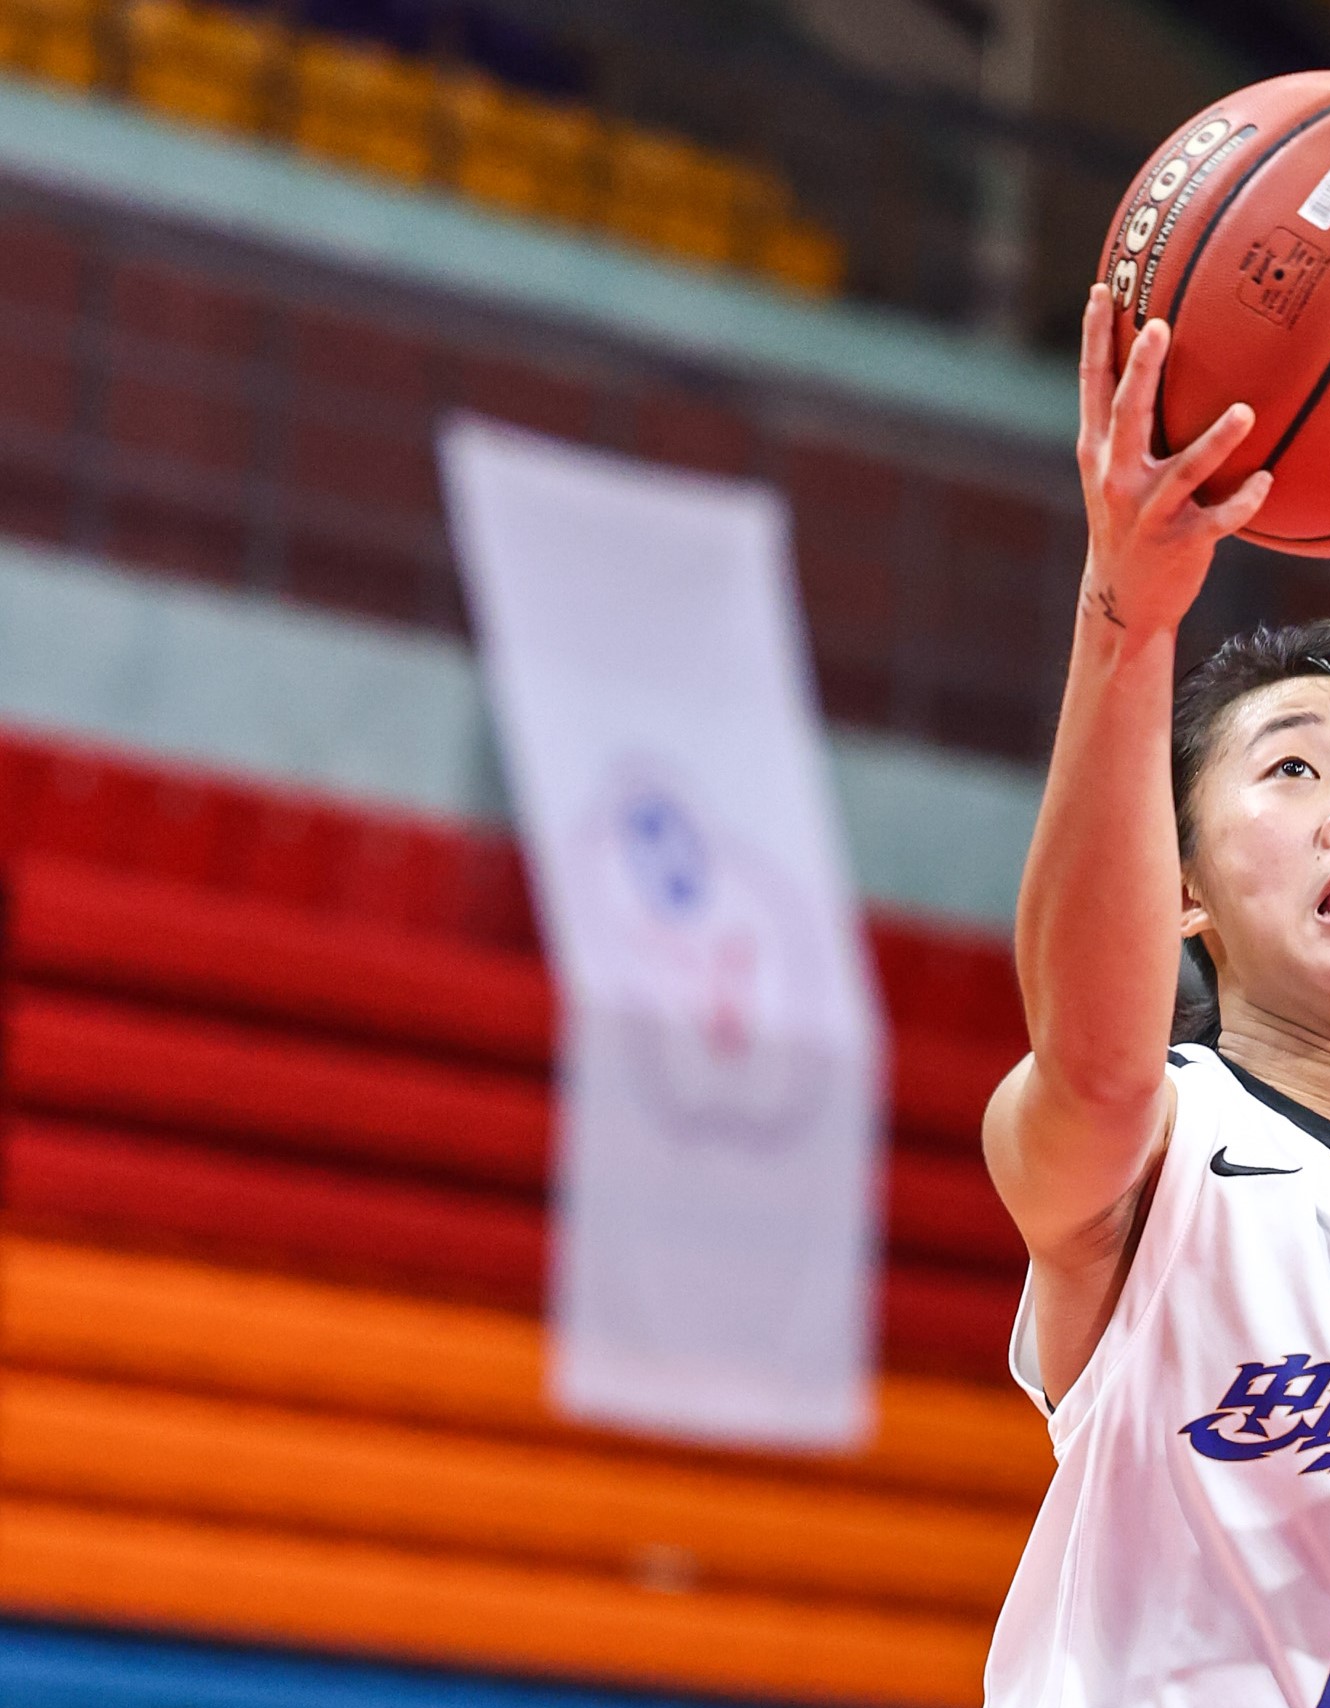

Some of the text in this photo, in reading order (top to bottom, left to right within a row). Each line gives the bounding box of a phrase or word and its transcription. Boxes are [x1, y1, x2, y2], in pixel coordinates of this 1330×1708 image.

[1111, 118, 1231, 313] 3600
[1136, 260, 1157, 316] MICRO
[1151, 171, 1206, 258] SYNTHETIC
